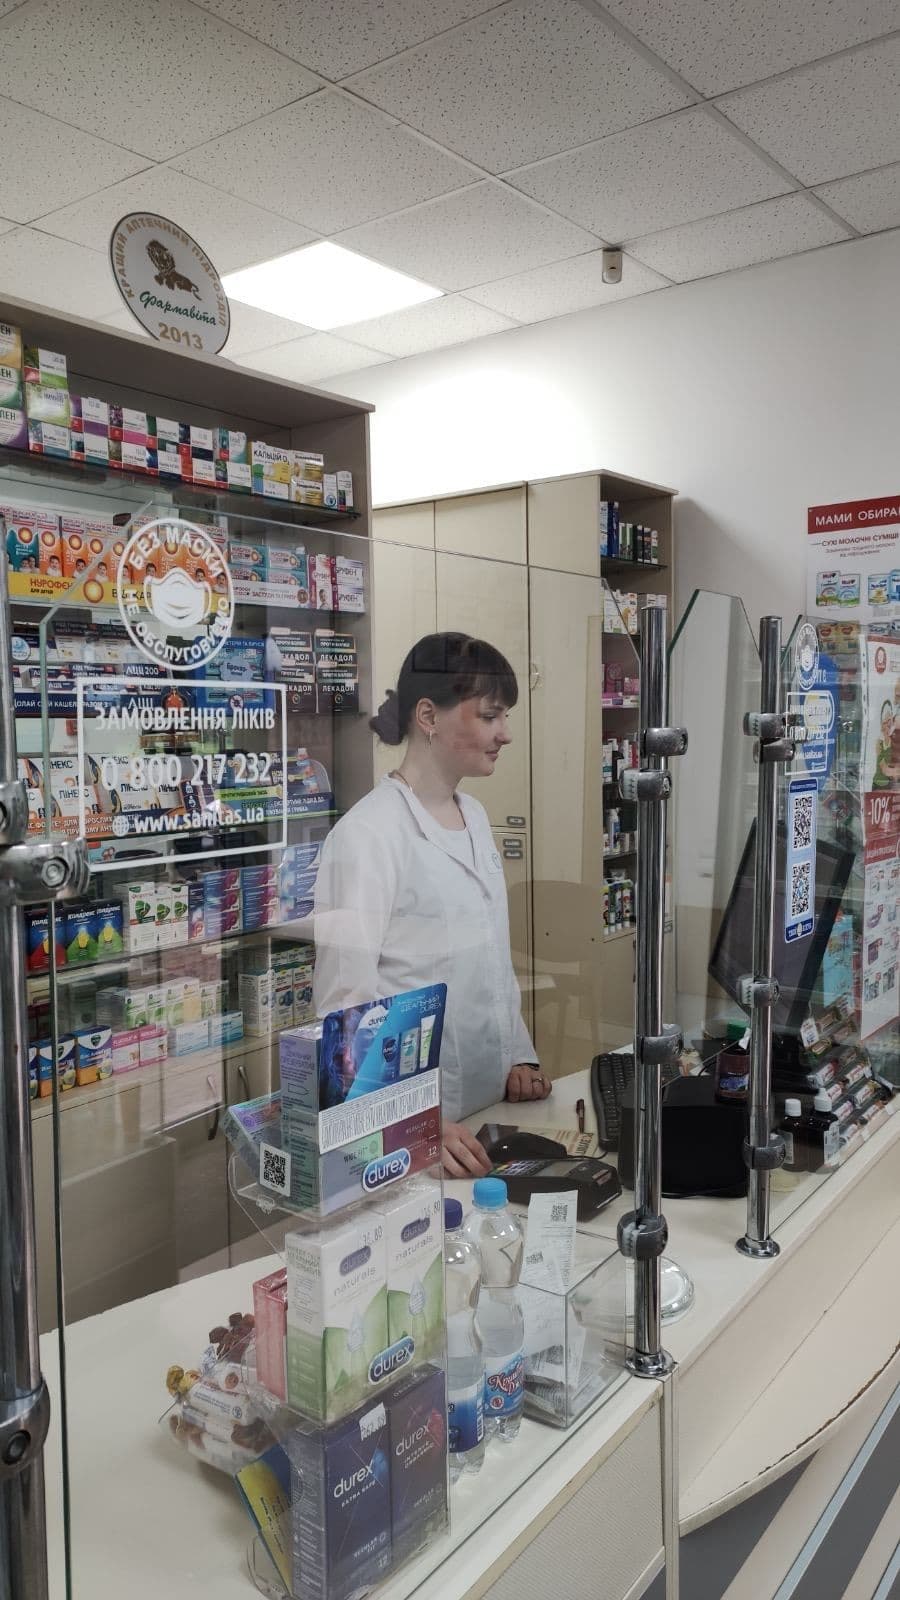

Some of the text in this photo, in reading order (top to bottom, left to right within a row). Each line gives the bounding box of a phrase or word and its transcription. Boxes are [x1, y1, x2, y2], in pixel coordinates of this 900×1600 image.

[158, 322, 204, 350] 2013
[815, 512, 853, 527] МАМИ
[128, 526, 224, 578] БЕЗ МАСКИ
[281, 653, 310, 662] ЕКАДОЛ
[95, 706, 276, 731] ЗАМОВЛЕННЯ ЛІКІВ
[102, 757, 118, 790] 0
[129, 753, 182, 788] 800
[191, 753, 227, 786] 217
[235, 752, 273, 784] 232
[867, 796, 891, 825] -10%
[428, 1145, 437, 1156] 12
[367, 1155, 407, 1184] durex
[373, 1344, 412, 1378] durex
[395, 1416, 432, 1456] durex
[333, 1457, 375, 1499] durex
